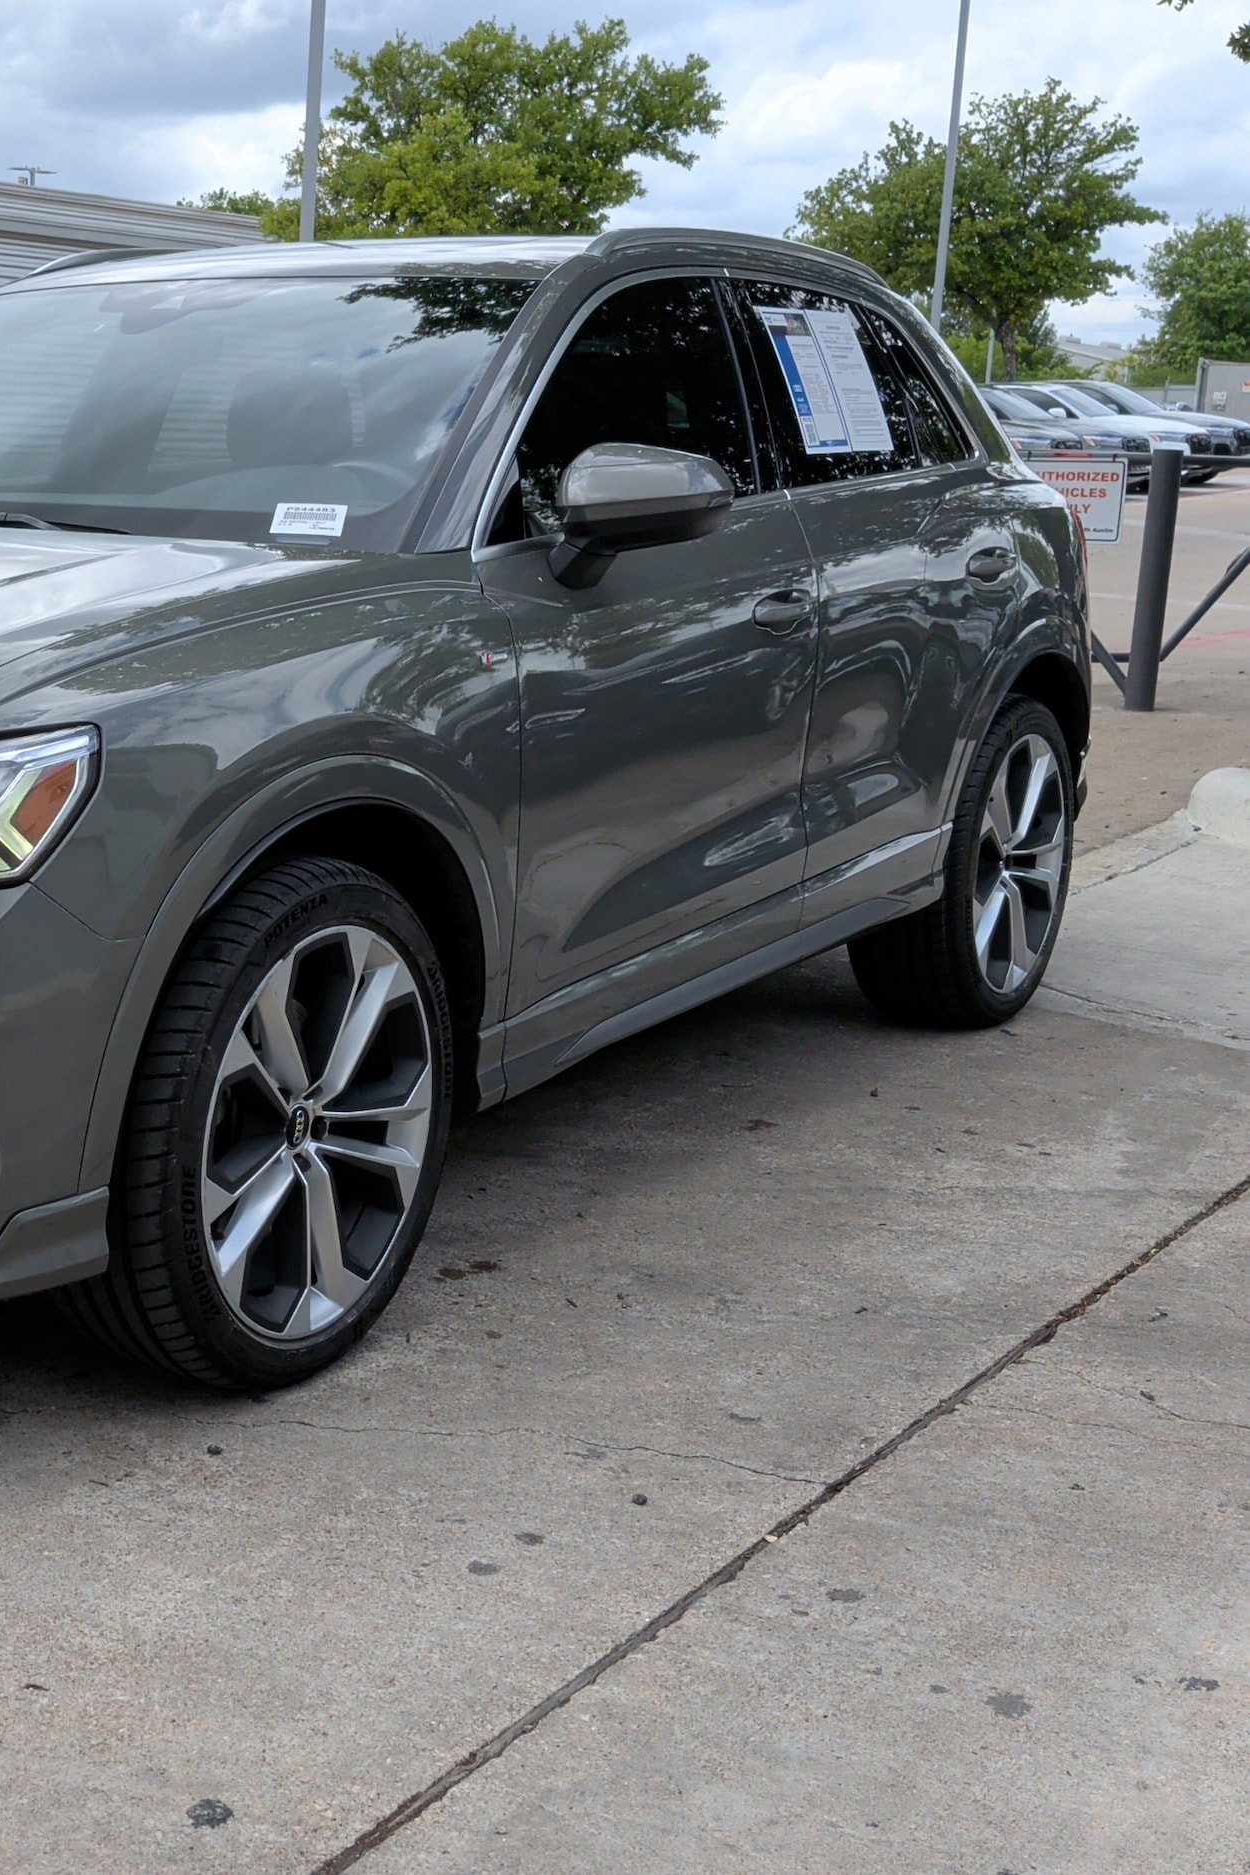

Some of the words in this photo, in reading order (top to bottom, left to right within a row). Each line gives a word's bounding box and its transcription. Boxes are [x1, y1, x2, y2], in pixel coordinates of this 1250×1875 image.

[1037, 472, 1119, 482] UTHORIZED
[262, 893, 329, 950] POTENZA
[181, 1164, 221, 1324] BRIDGESTONE
